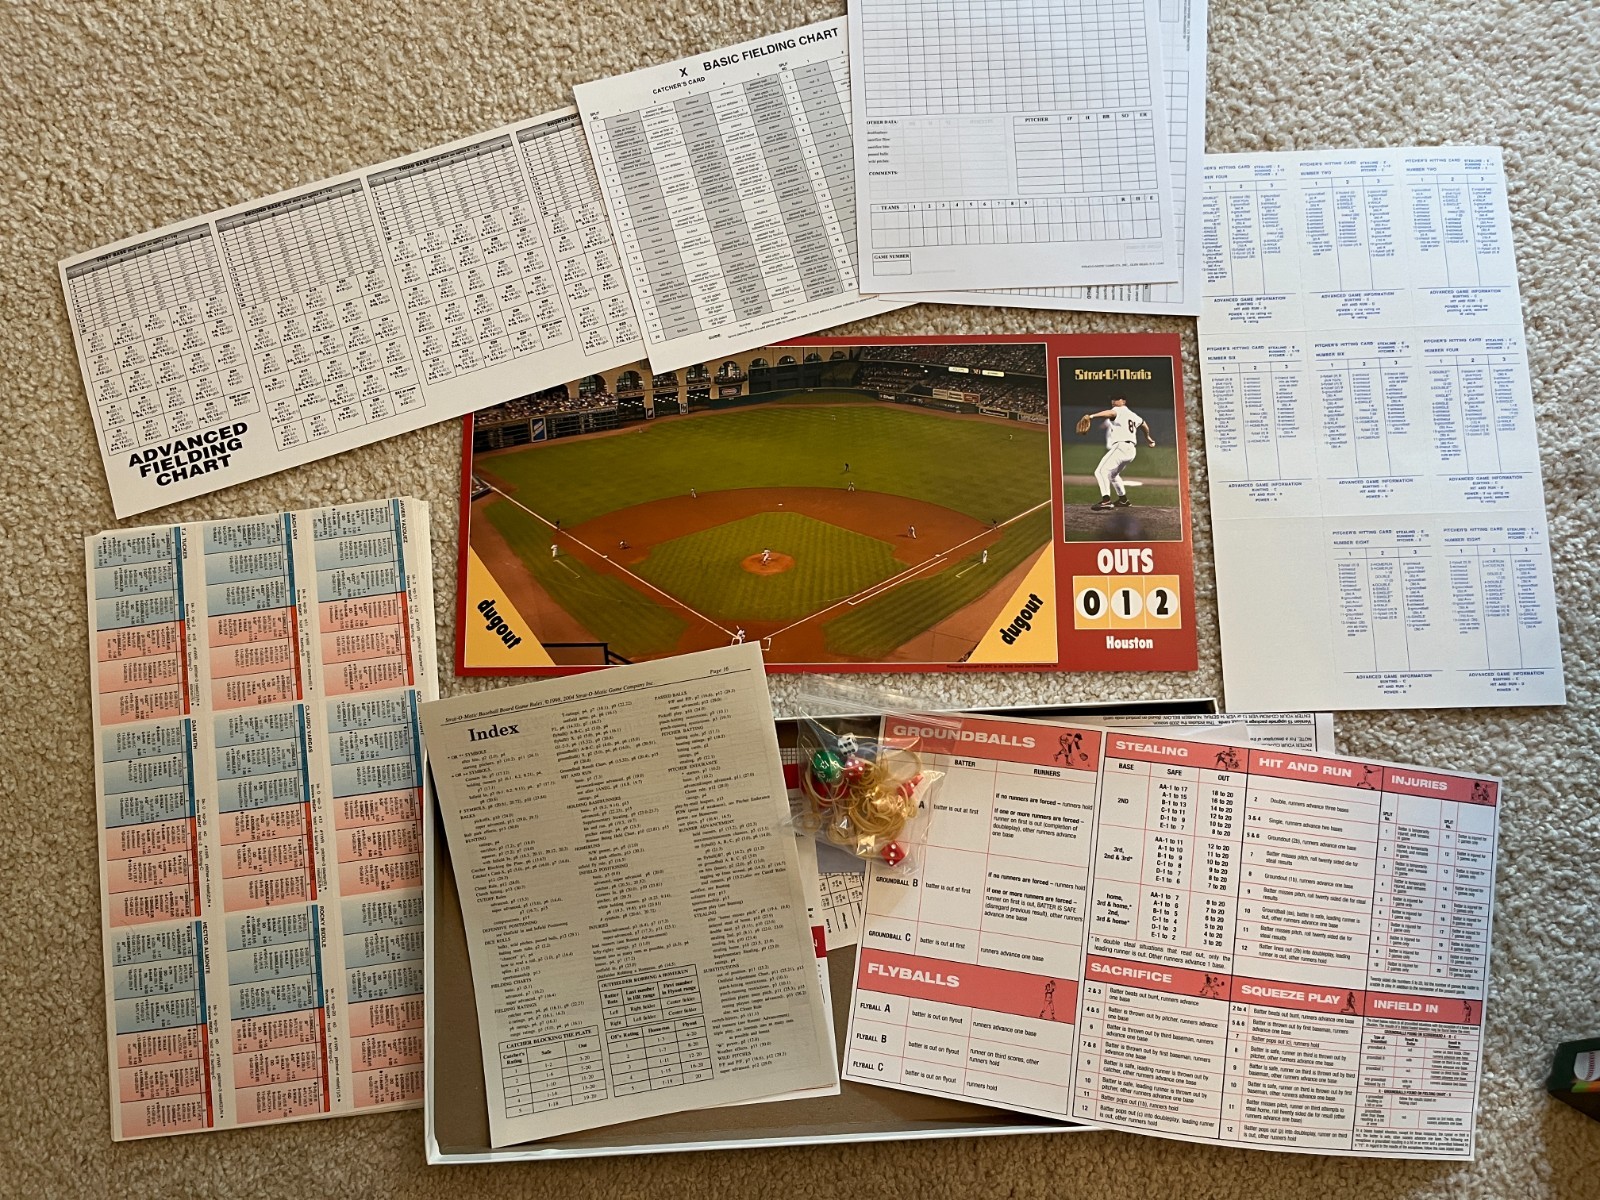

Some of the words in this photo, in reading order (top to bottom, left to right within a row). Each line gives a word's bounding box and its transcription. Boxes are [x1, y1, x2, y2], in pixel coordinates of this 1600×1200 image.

[680, 68, 688, 77] X
[703, 54, 740, 71] BASIC
[741, 40, 796, 60] FIELDING
[798, 28, 839, 45] CHART
[652, 80, 687, 94] CATCHER'S
[688, 76, 705, 87] CARD
[1075, 369, 1151, 380] Strat-O-Matic
[128, 422, 248, 468] ADVANCED
[139, 438, 243, 479] FIELDING
[156, 454, 232, 487] CHART
[1097, 548, 1153, 574] OUTS
[1084, 589, 1100, 615] 0
[1122, 589, 1131, 615] 1
[1156, 589, 1169, 615] 2
[477, 598, 522, 650] dugout
[998, 593, 1045, 646] dugout
[1106, 635, 1153, 649] Houston
[468, 723, 520, 742] Index
[893, 725, 1036, 748] GROUNDBALLS
[1116, 741, 1188, 757] STEALING
[955, 759, 975, 767] BATTER
[1259, 758, 1283, 768] HIT
[1288, 762, 1318, 773] AND
[1323, 766, 1352, 777] RUN
[1034, 768, 1060, 777] RUNNERS
[1391, 775, 1448, 791] INJURIES
[919, 801, 925, 809] A
[876, 876, 909, 886] GROUNDBALL
[912, 879, 918, 887] B
[869, 930, 902, 941] GROUNDBALL
[905, 933, 911, 942] C
[867, 962, 960, 988] FLYBALLS
[1091, 963, 1172, 983] SACRIFICE
[1242, 985, 1305, 1001] SQUEEZE
[1308, 994, 1341, 1004] PLAY
[860, 1003, 881, 1012] FLYBALL
[884, 1004, 891, 1012] A
[1374, 1000, 1422, 1012] INFIELD
[1426, 1005, 1439, 1013] IN
[973, 1021, 991, 1029] runners
[993, 1025, 1013, 1033] advance
[506, 1040, 532, 1049] CATCHER
[534, 1034, 562, 1044] BLOCKING
[856, 1033, 878, 1043] FLYBALL
[881, 1035, 887, 1043] B
[853, 1061, 874, 1070] FLYBALL
[878, 1063, 884, 1072] C
